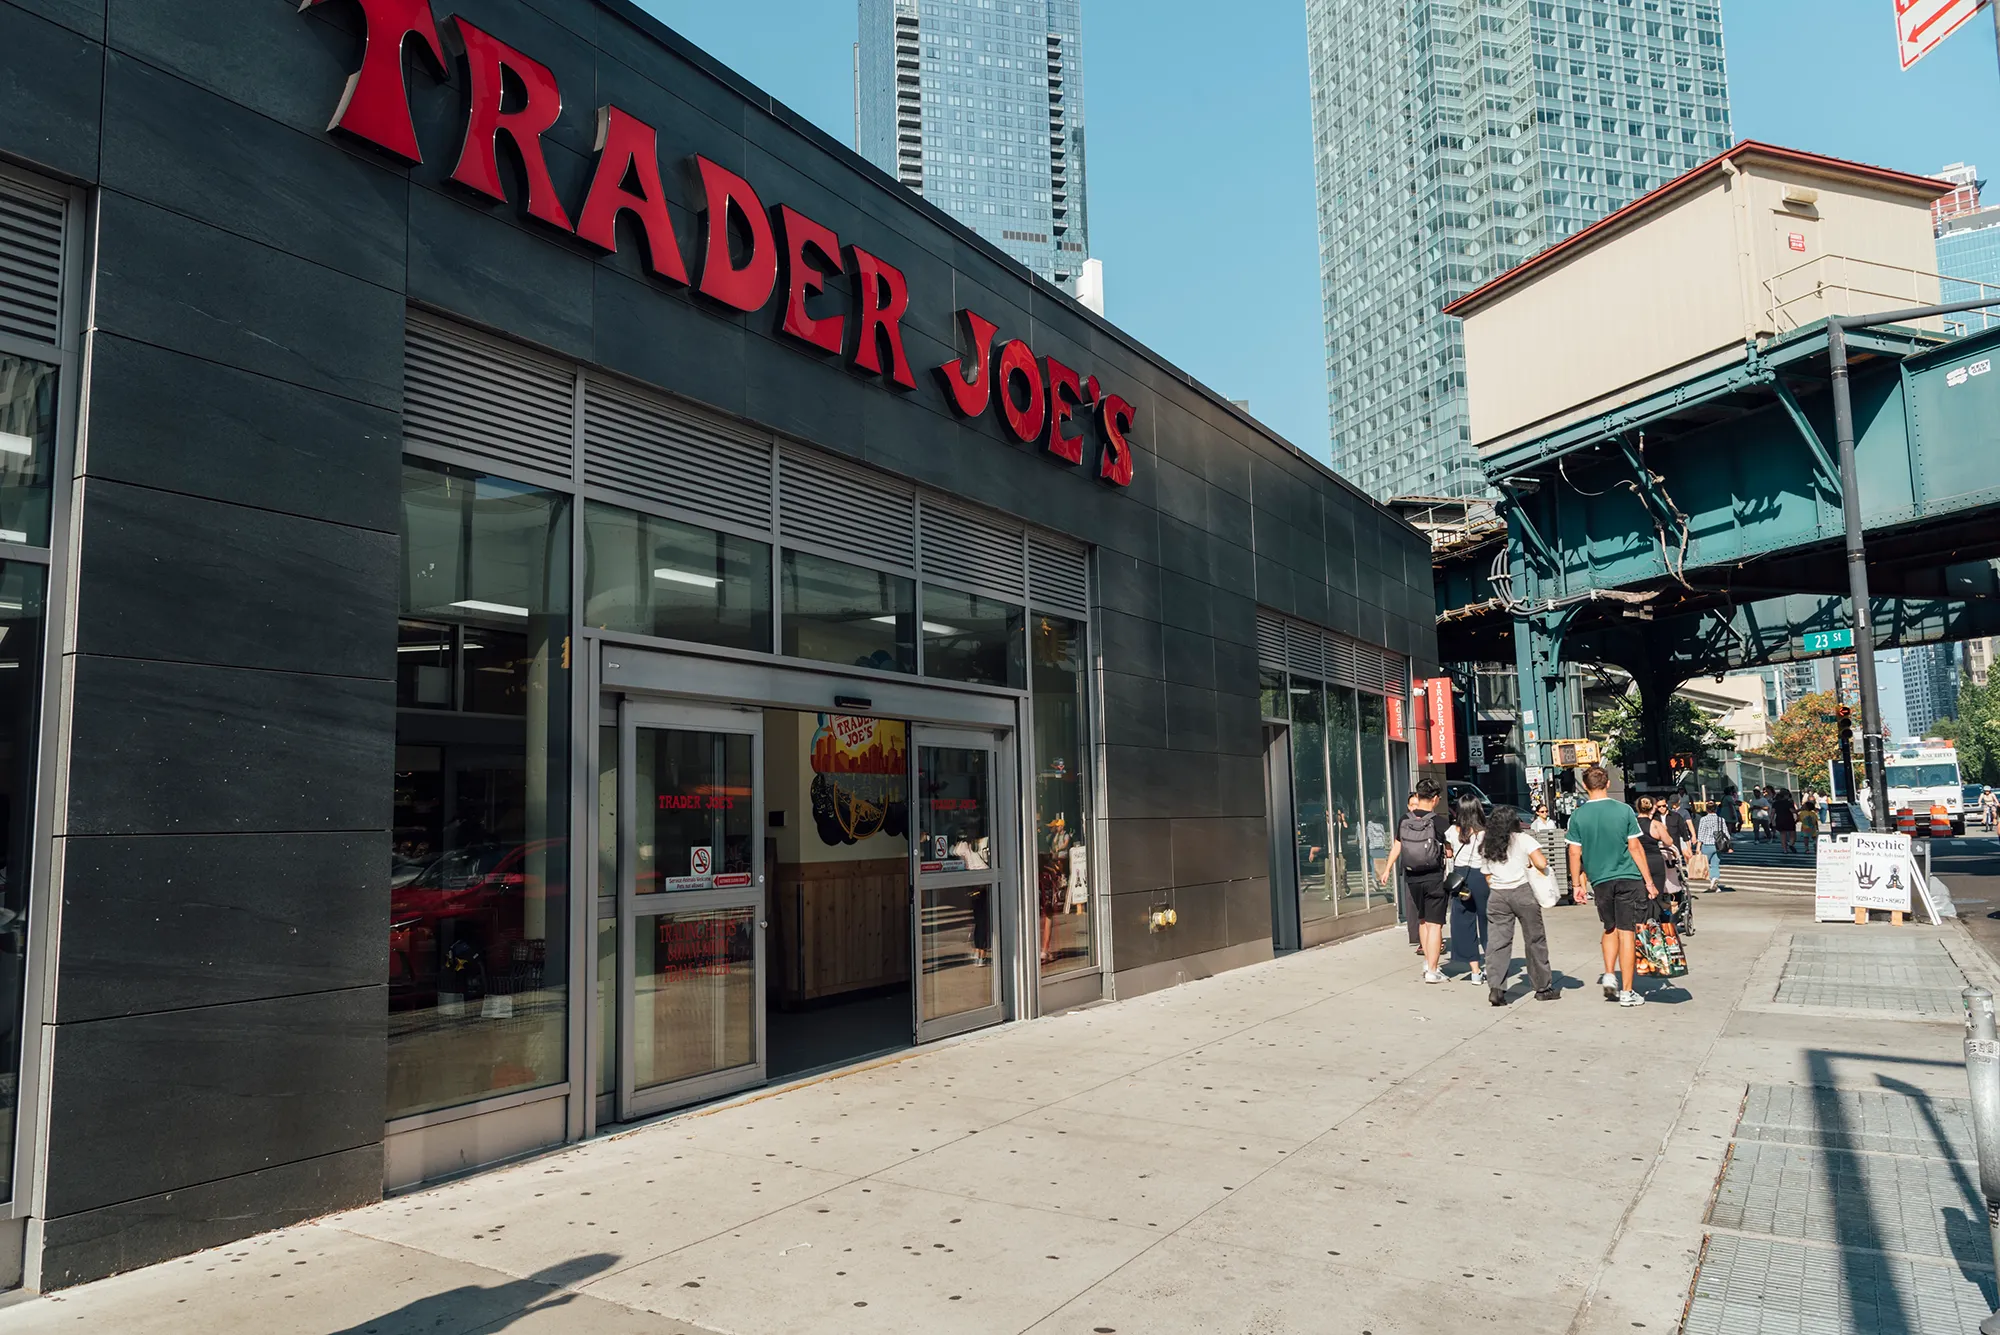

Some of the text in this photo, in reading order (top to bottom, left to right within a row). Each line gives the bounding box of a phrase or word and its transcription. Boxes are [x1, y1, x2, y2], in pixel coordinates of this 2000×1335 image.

[298, 0, 1137, 488] TRADER JOE'S
[1814, 632, 1842, 649] 23 St
[1435, 681, 1447, 760] TRADER JOE'S
[845, 725, 873, 748] JOE'S
[1470, 747, 1483, 757] 25
[658, 795, 735, 809] TRADER JOE'S
[1856, 838, 1905, 851] Psychic
